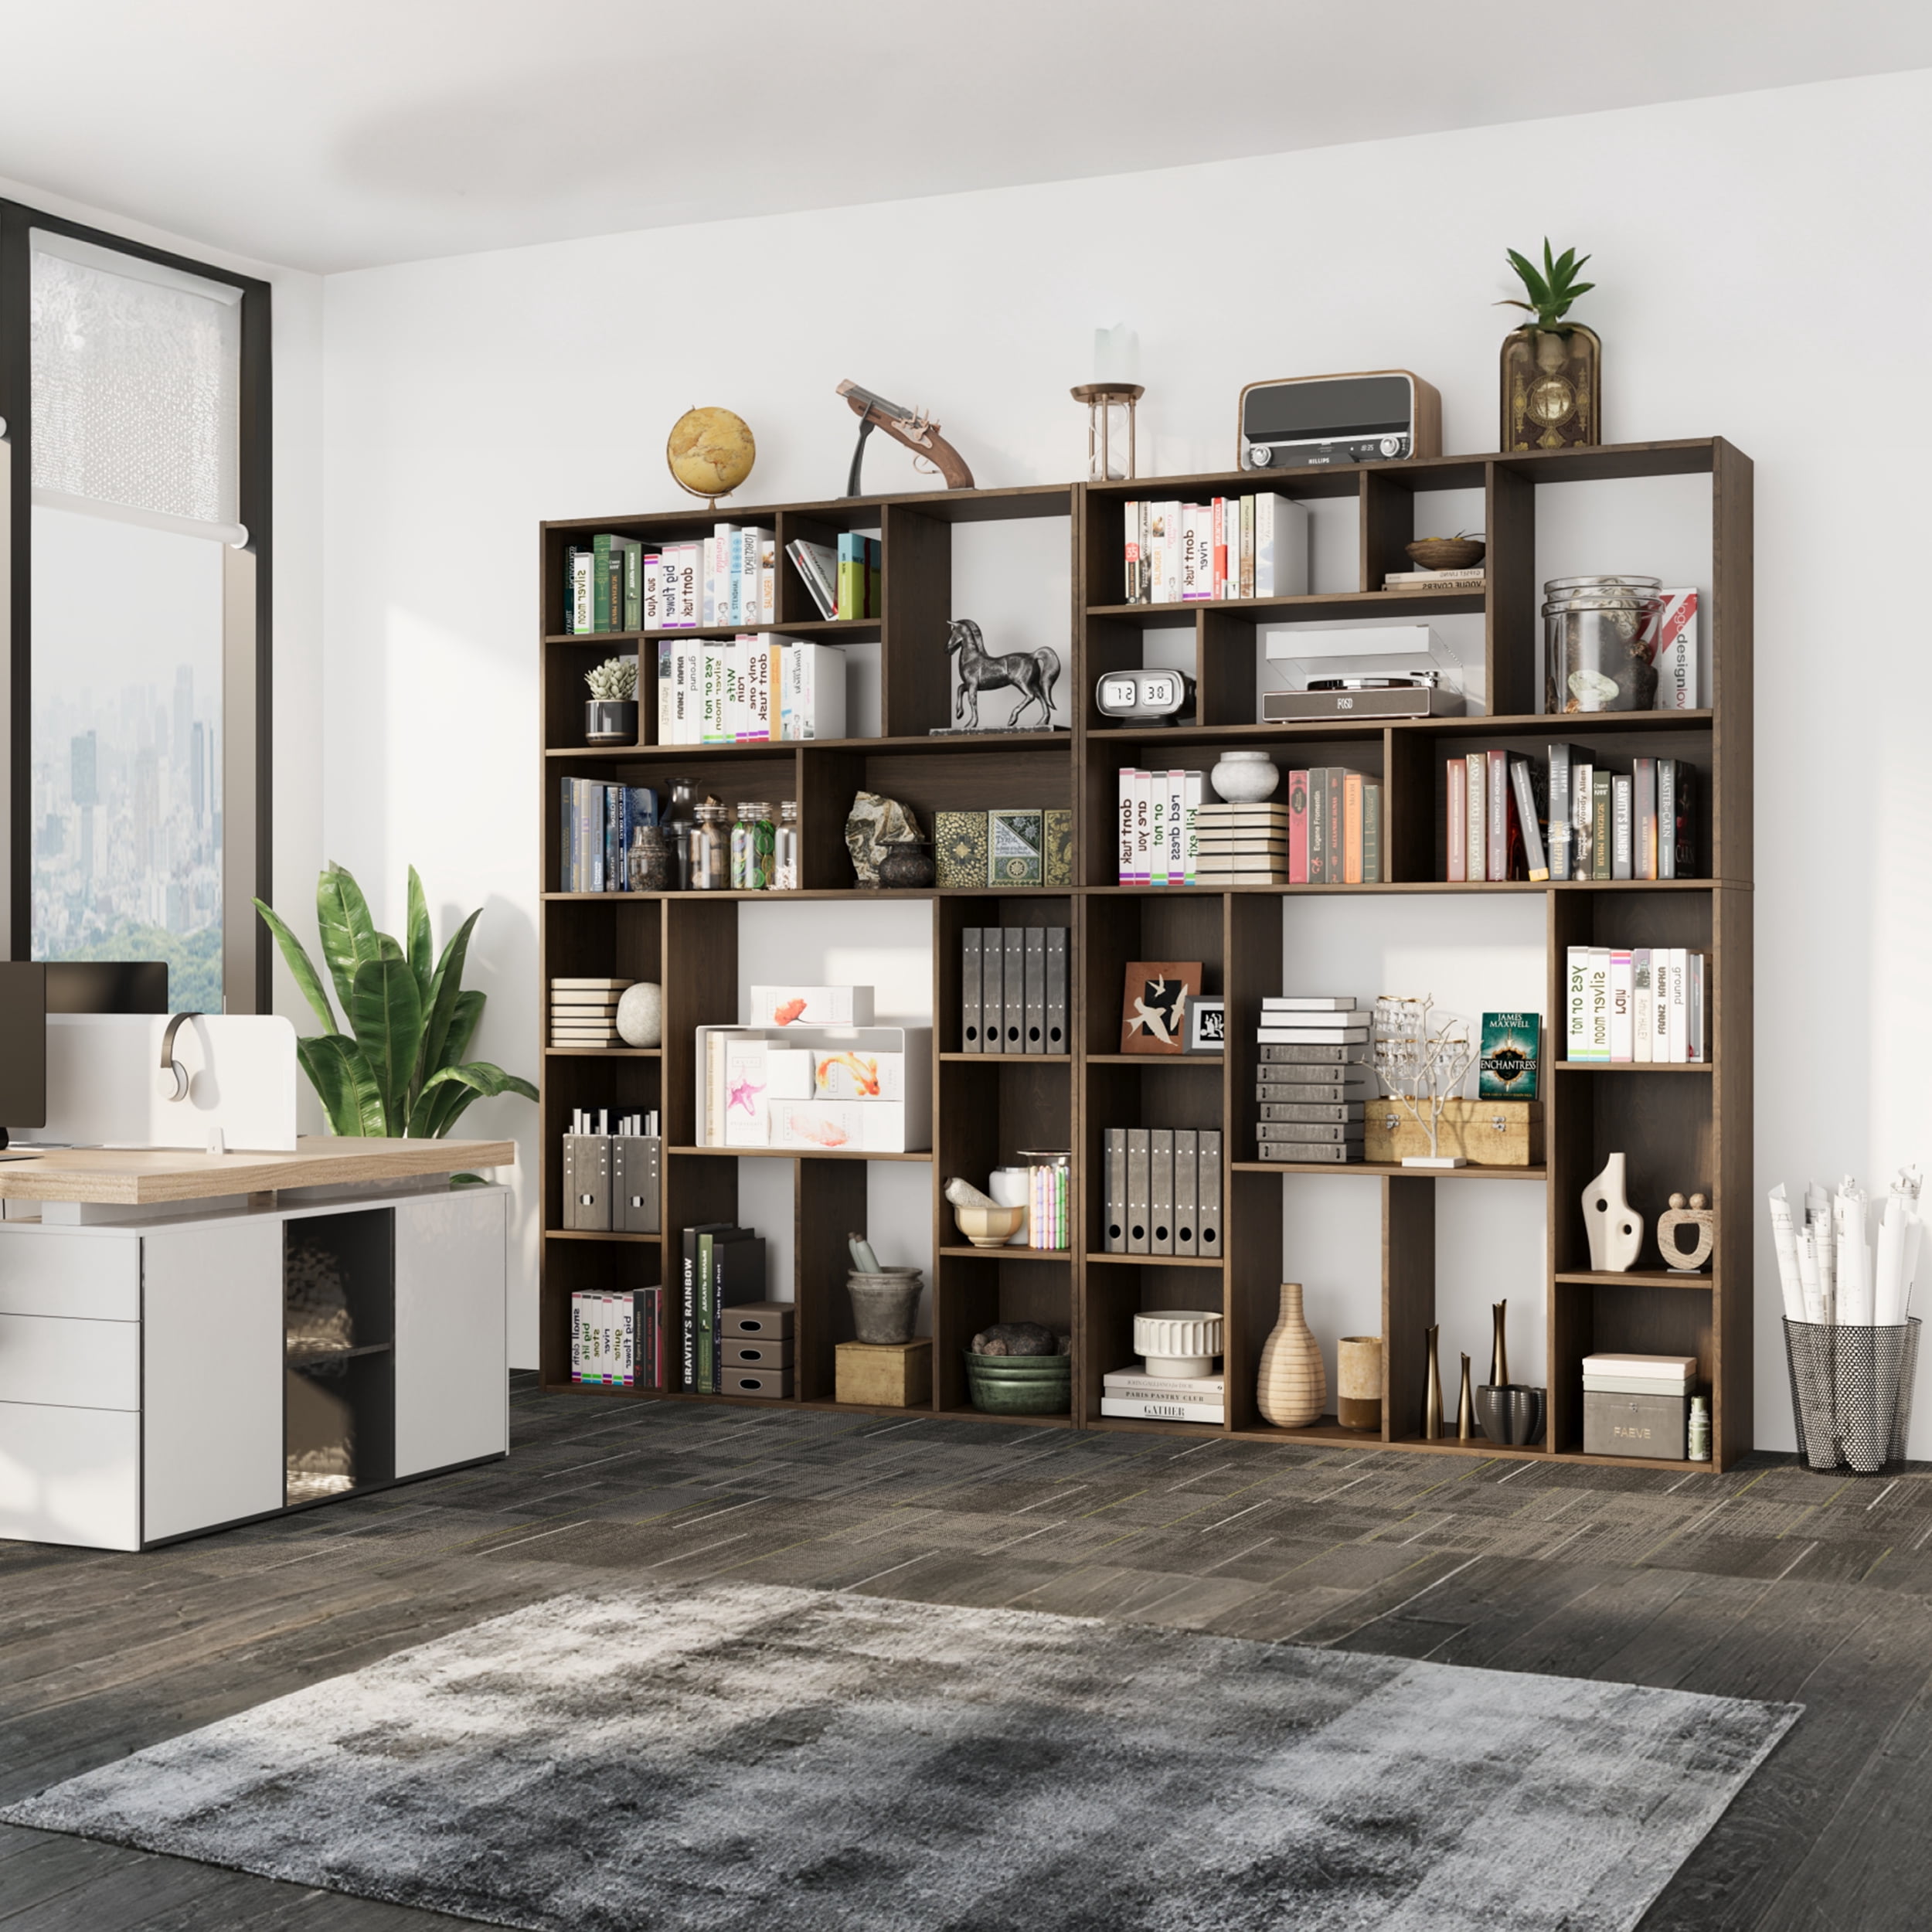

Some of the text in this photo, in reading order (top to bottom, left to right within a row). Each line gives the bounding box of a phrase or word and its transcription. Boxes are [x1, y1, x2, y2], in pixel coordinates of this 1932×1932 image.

[764, 580, 773, 609] SALINGER
[689, 656, 698, 691] ground
[1117, 686, 1164, 700] 12 30
[1662, 773, 1671, 808] MASTER
[1579, 795, 1587, 825] Woody
[1617, 781, 1628, 863] GRAVITY'S RAINBOW
[1662, 811, 1671, 838] CARN
[1672, 966, 1683, 1005] ground
[1658, 967, 1666, 1035] FRANZ KAFKA
[1480, 1060, 1536, 1070] ENCHANTRESS
[716, 1286, 722, 1297] by
[684, 1258, 692, 1384] GRAVITY'S RAINBOW
[1144, 1405, 1185, 1417] GATHER
[1614, 1427, 1651, 1439] FAEVE
